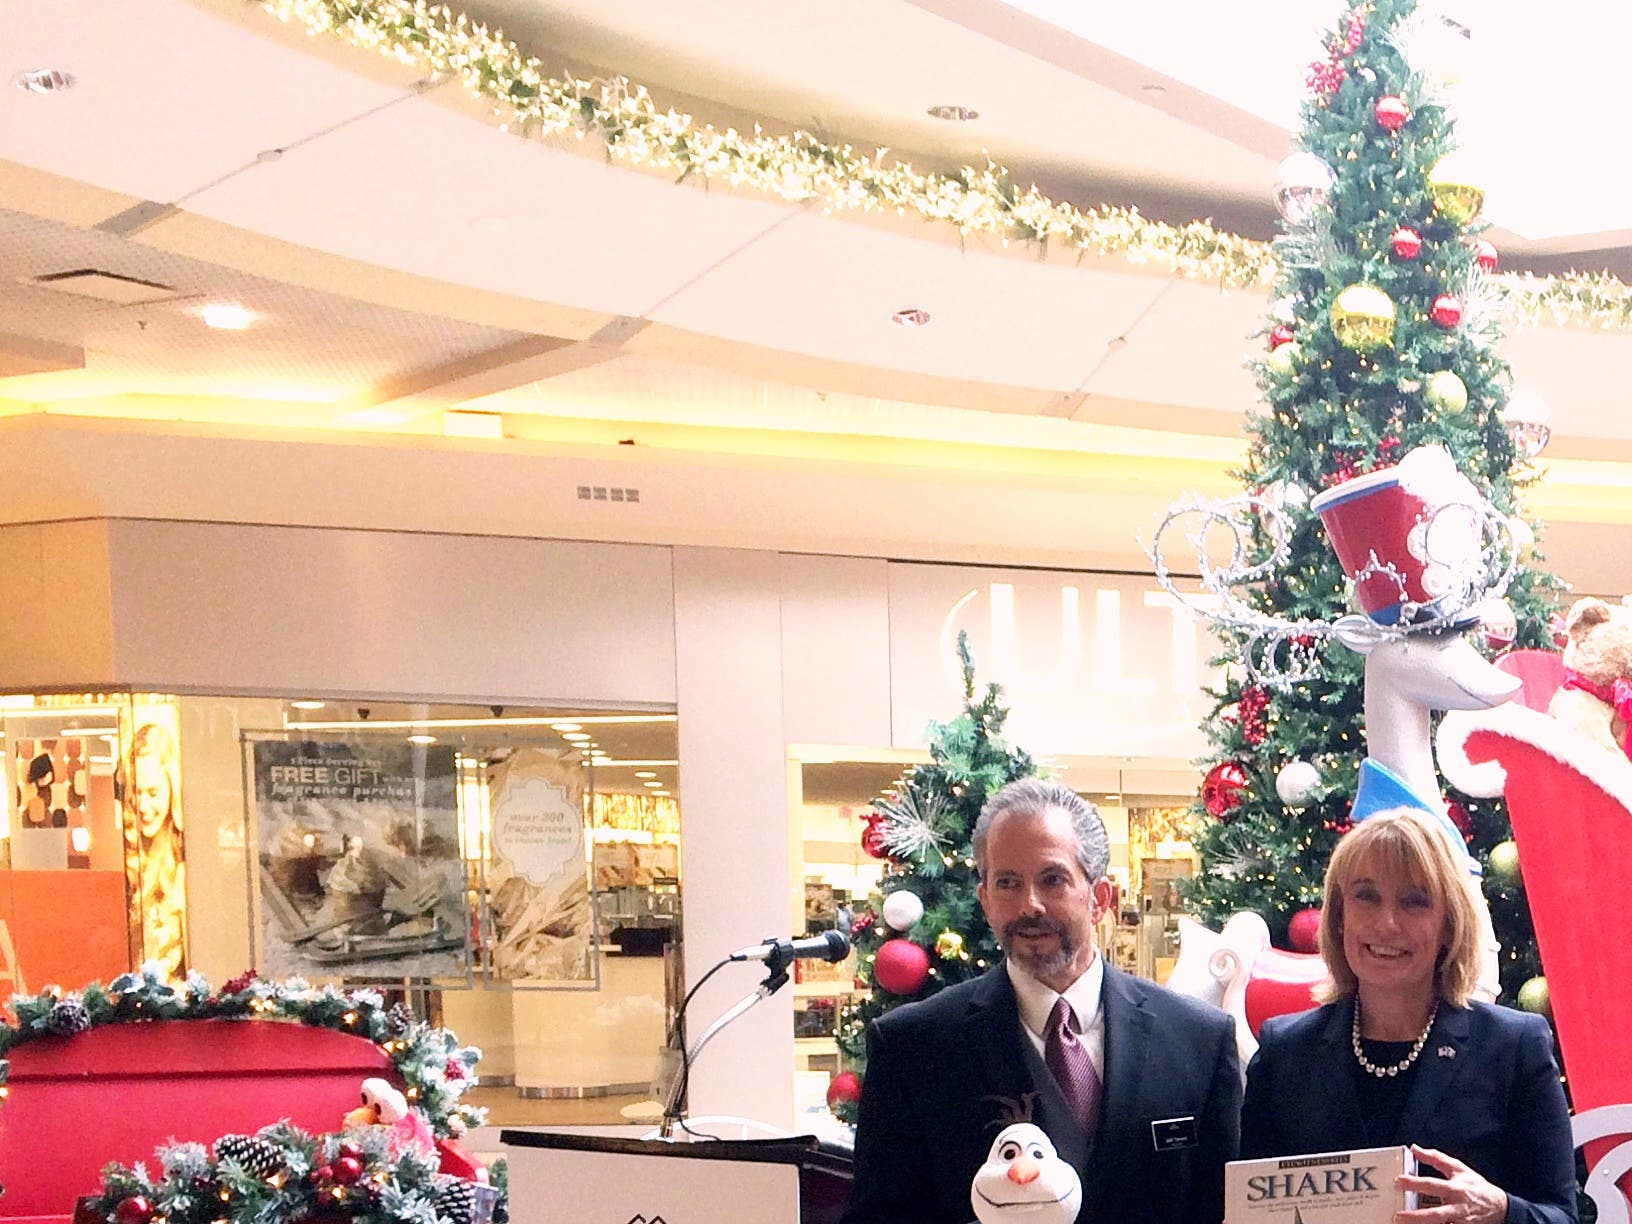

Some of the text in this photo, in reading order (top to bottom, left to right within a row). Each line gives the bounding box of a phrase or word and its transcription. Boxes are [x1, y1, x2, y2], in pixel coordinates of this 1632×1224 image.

[989, 583, 1230, 695] ULT
[270, 766, 329, 783] FREE
[335, 768, 382, 784] GIFT
[352, 786, 413, 799] purchas
[503, 822, 572, 835] fragrances
[1246, 1165, 1378, 1202] SHARK
